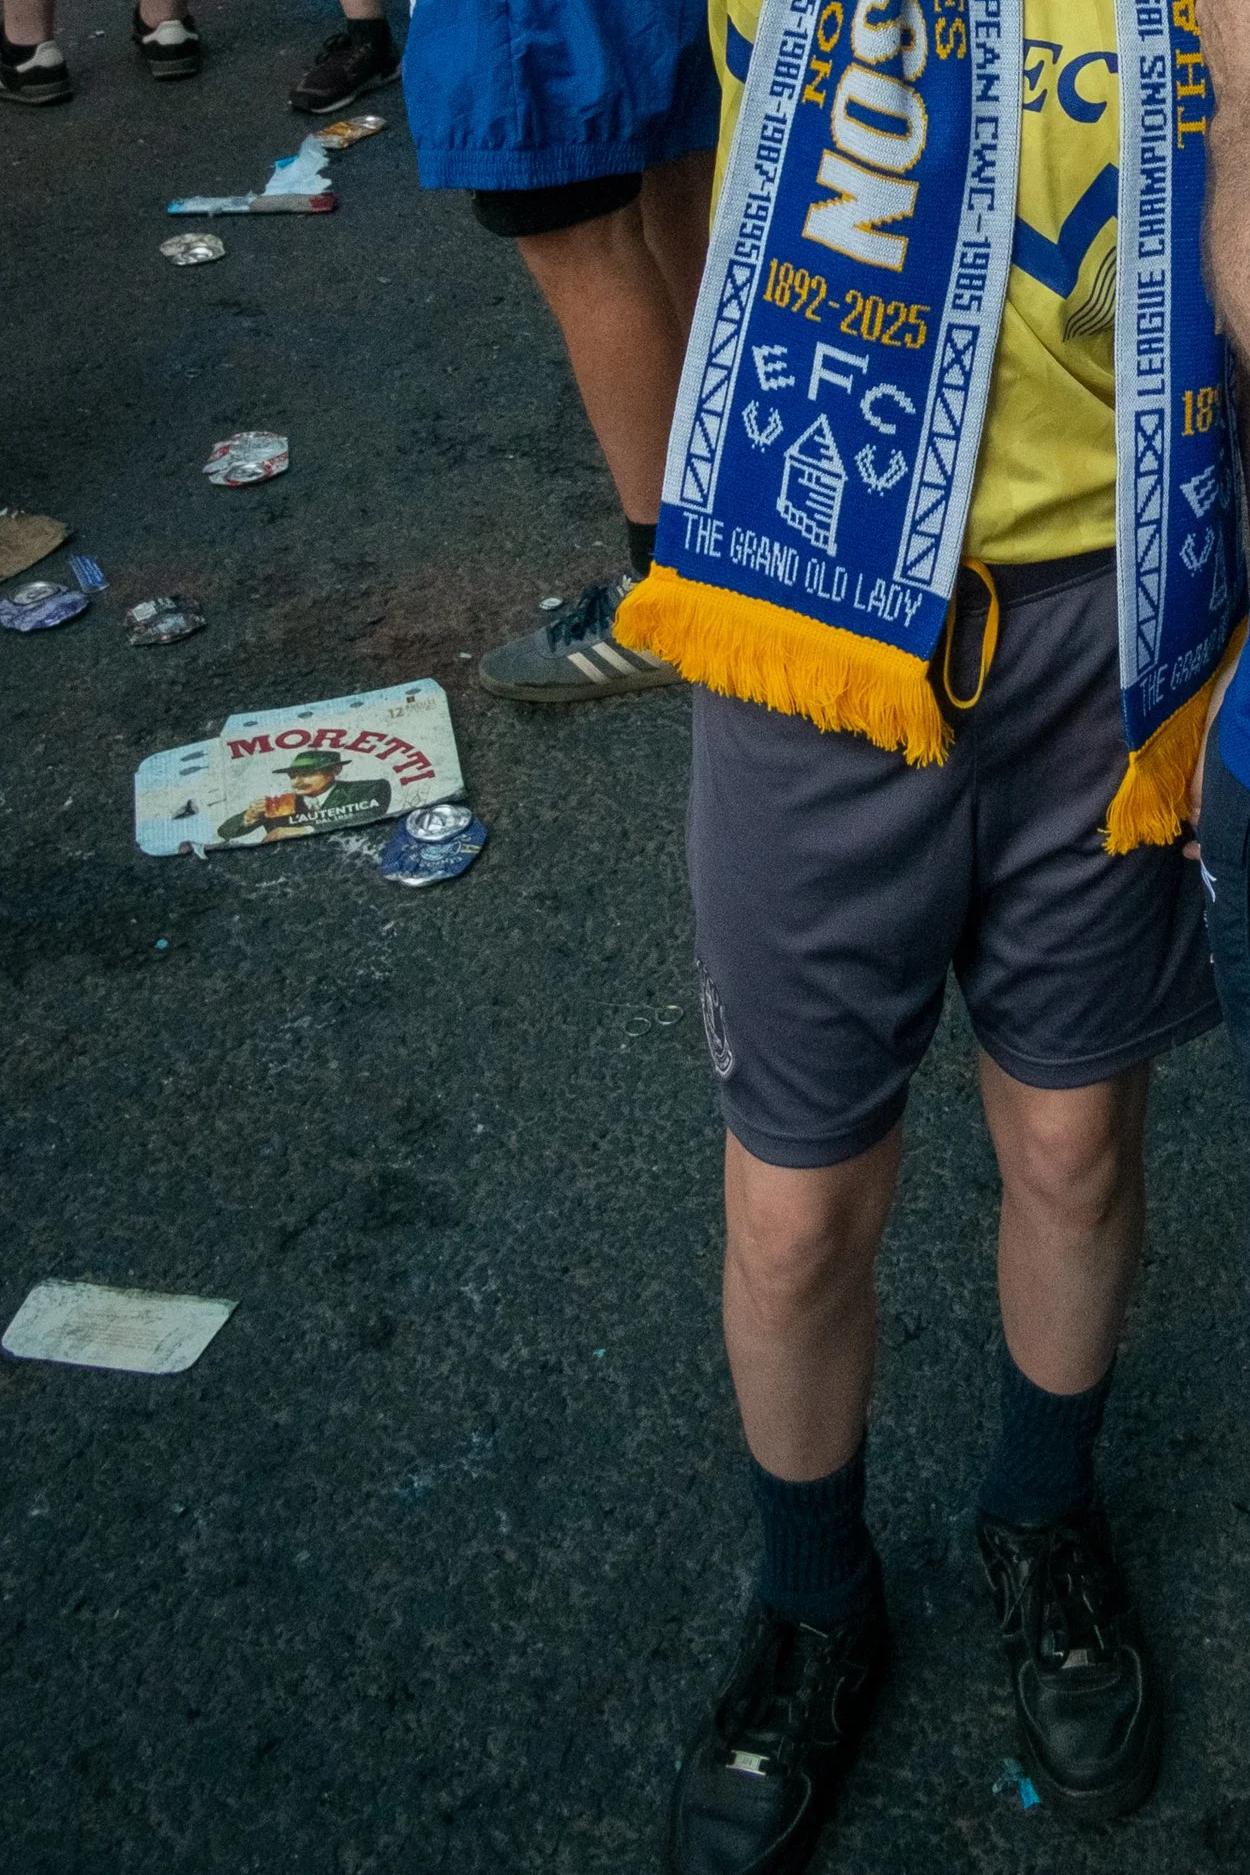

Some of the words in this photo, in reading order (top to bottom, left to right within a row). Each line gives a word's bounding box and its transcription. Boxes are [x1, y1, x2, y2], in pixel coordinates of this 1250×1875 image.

[1137, 55, 1166, 259] CHAMPIONS
[762, 258, 932, 350] 1892-2025
[1137, 270, 1166, 397] LEAGUE
[682, 511, 725, 558] THE
[730, 527, 799, 585] GRAND
[805, 557, 847, 602] OLD
[854, 574, 924, 628] LADY
[226, 728, 436, 787] MORETTI
[288, 798, 381, 826] L'AUTENTICA
